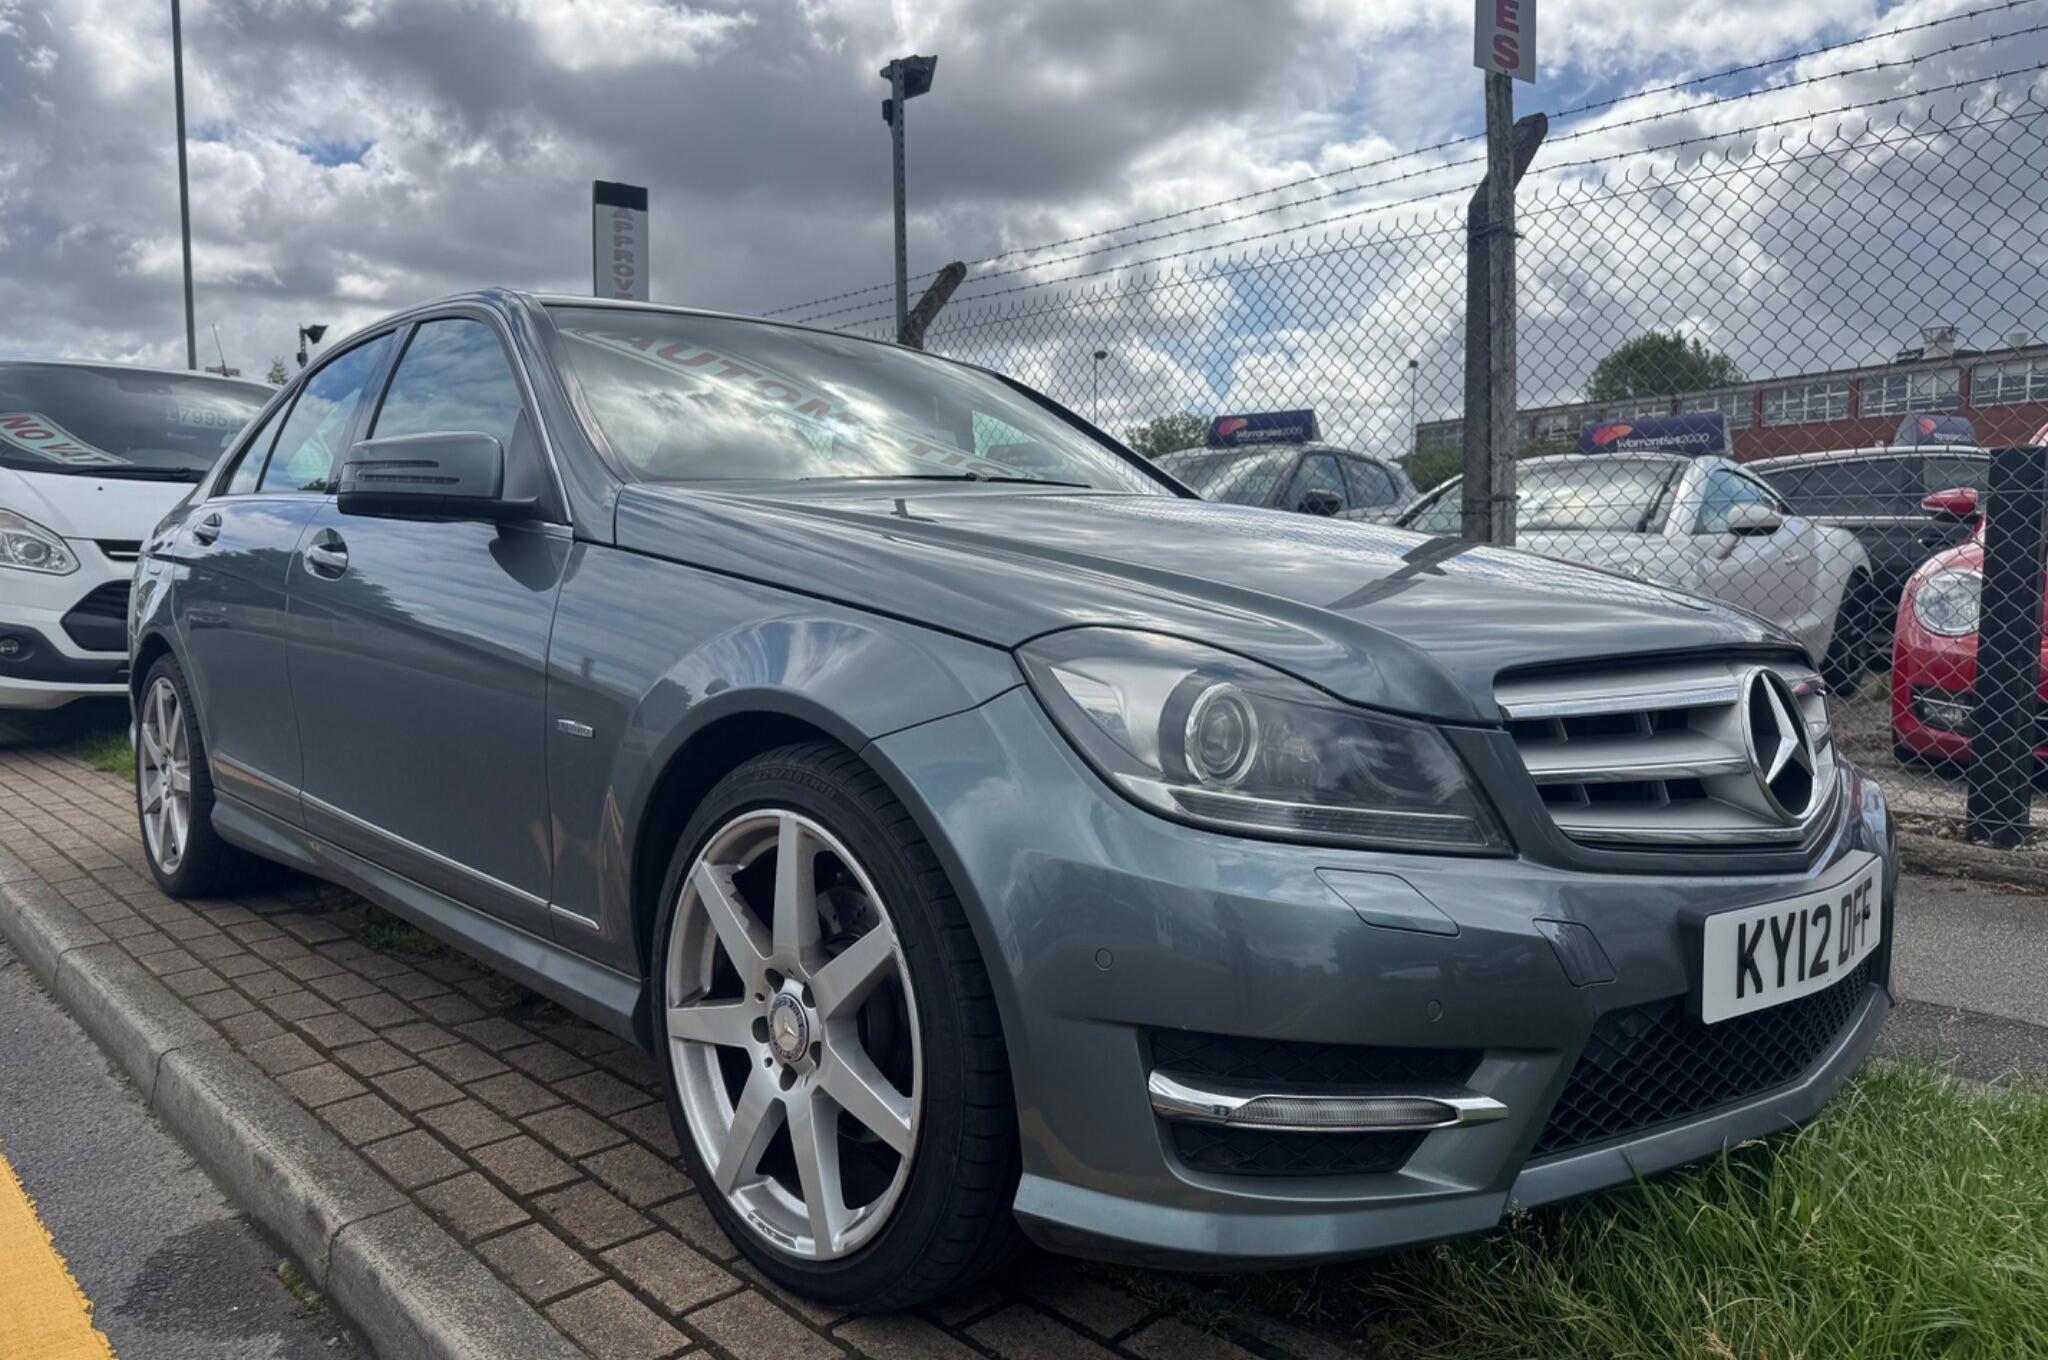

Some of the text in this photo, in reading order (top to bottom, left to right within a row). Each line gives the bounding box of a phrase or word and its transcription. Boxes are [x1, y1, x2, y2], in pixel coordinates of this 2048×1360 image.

[0, 415, 55, 440] NO
[598, 333, 1013, 476] AUTOMTIC
[1736, 876, 1873, 999] KY12 DFF
